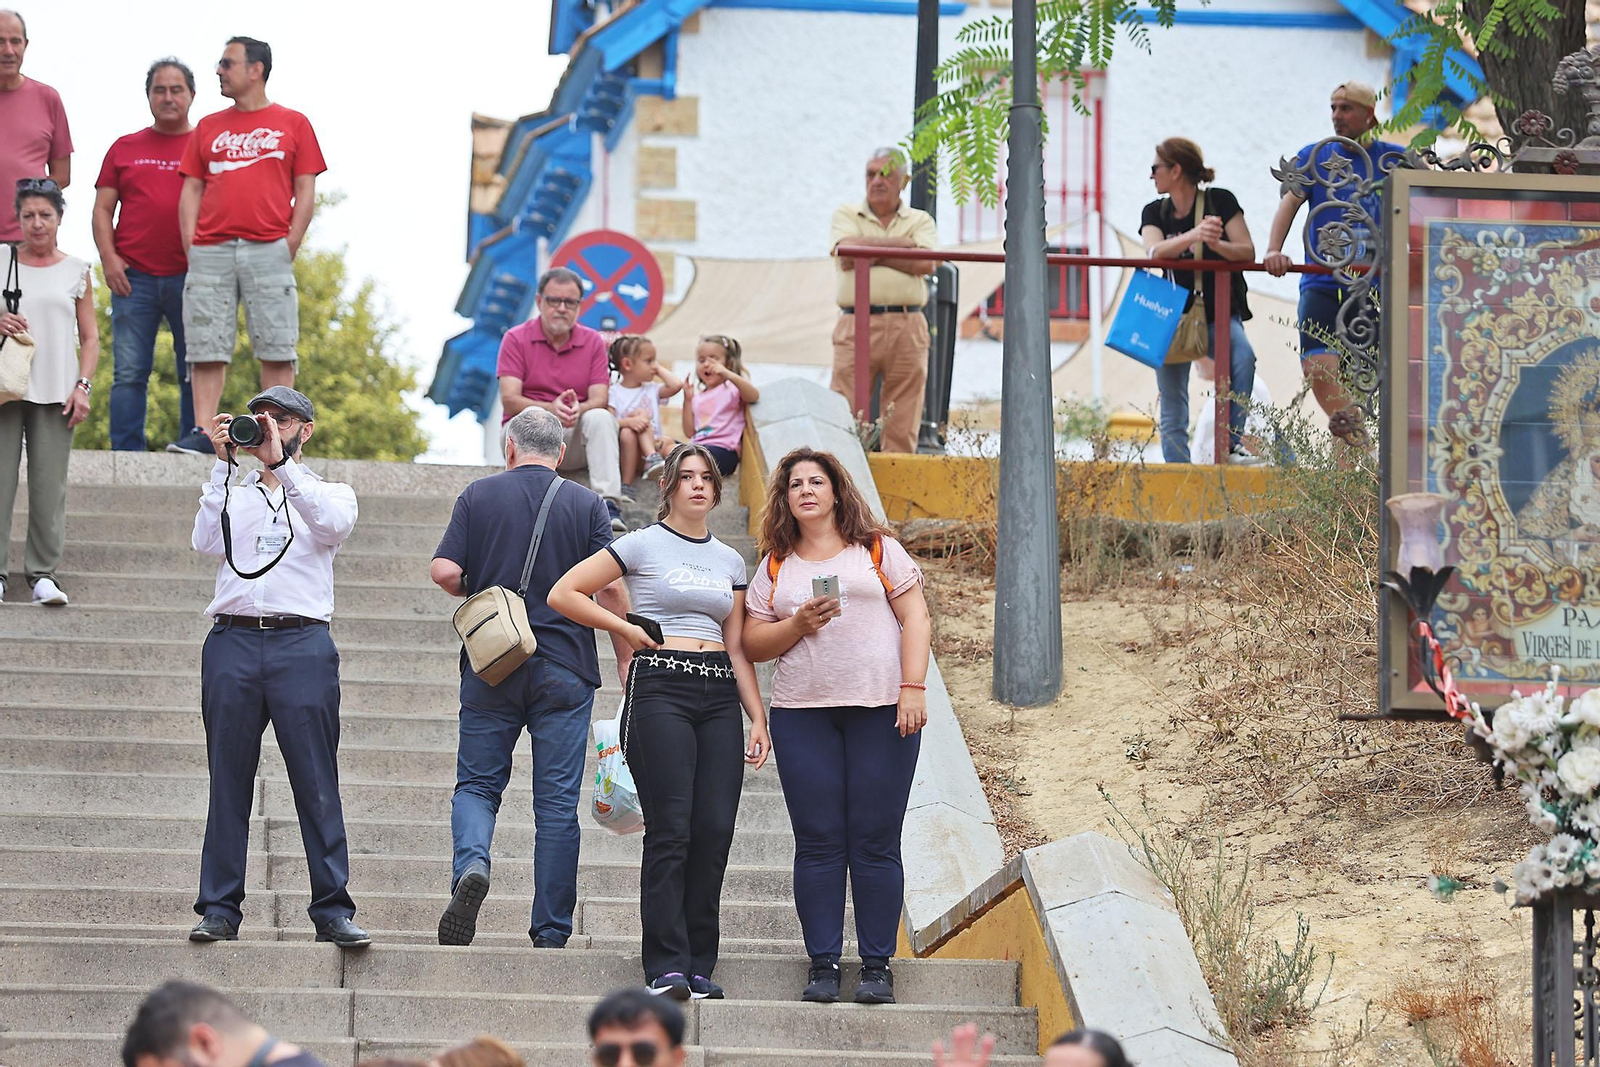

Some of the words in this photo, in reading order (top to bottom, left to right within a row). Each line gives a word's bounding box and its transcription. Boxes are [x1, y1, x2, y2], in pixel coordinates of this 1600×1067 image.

[1133, 292, 1170, 317] Huelva
[1521, 631, 1572, 662] VIRGEN
[1577, 639, 1592, 659] DE
